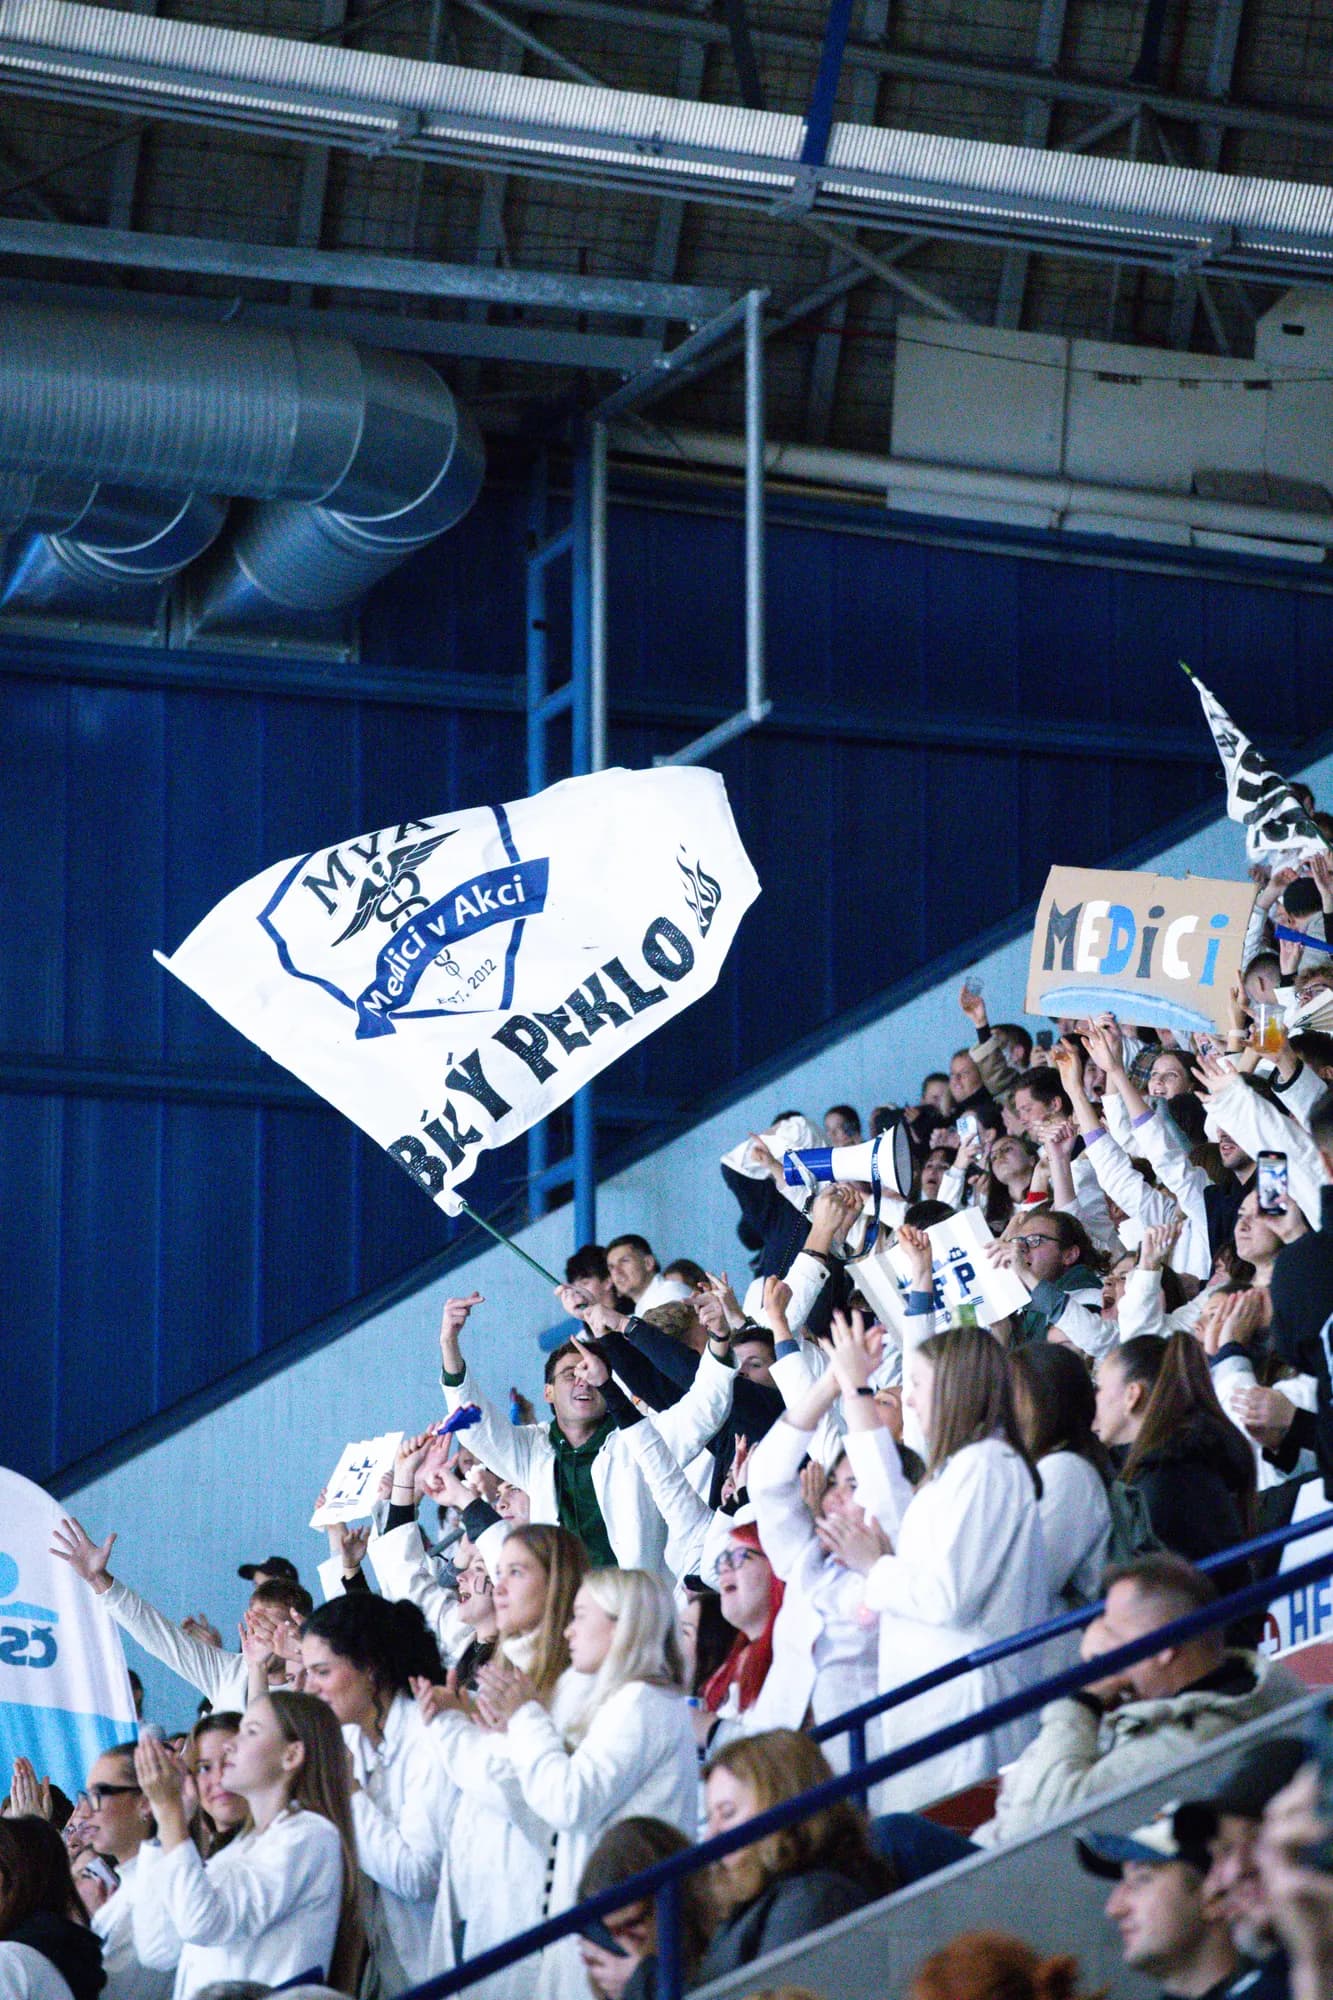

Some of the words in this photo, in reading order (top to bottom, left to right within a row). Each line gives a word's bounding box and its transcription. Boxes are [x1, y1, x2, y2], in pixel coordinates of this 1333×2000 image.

[301, 820, 435, 916] MVA
[362, 925, 427, 1018] Medici
[426, 915, 446, 937] v
[453, 874, 526, 927] Akci
[467, 958, 498, 990] 2012
[491, 916, 695, 1085] PEKLO
